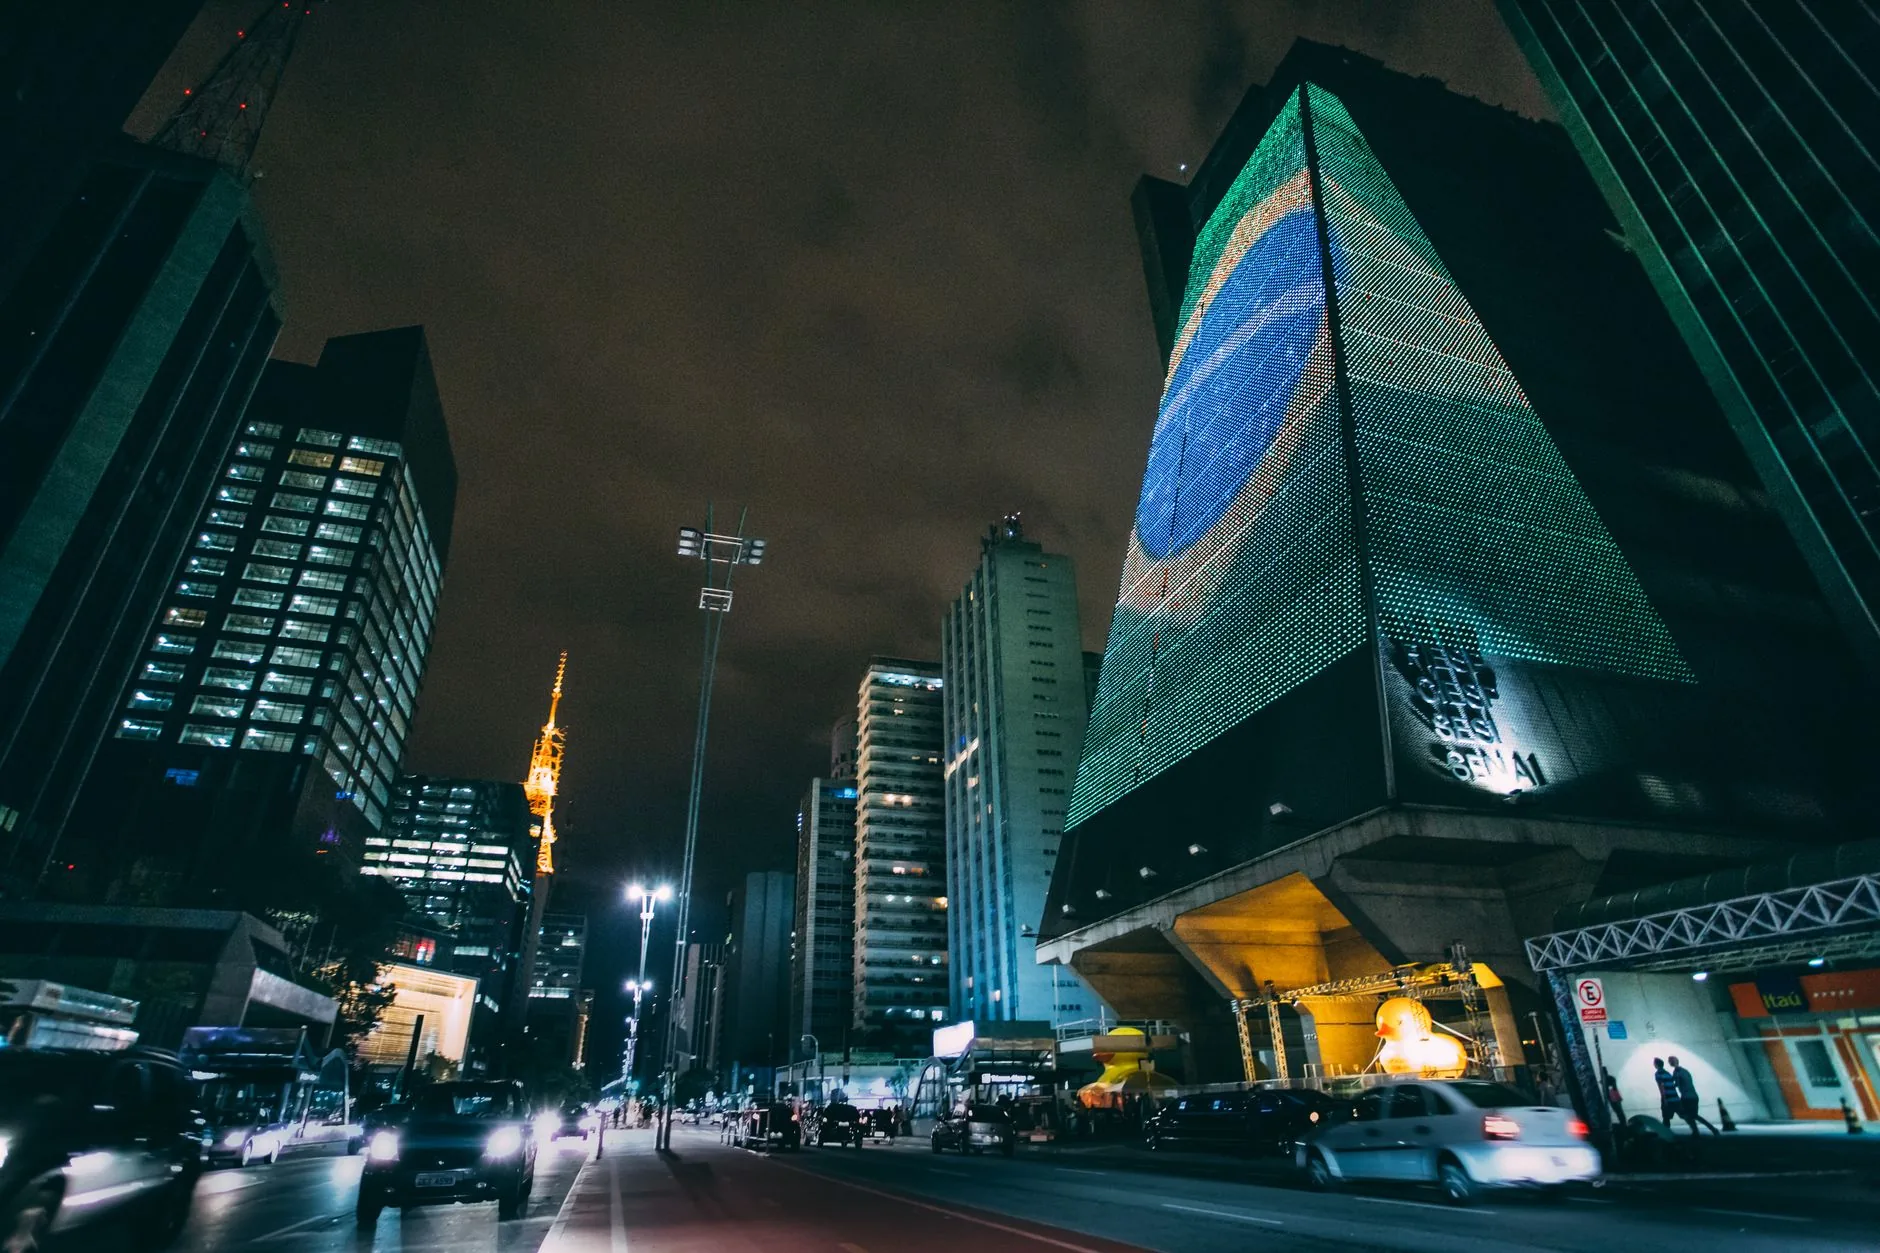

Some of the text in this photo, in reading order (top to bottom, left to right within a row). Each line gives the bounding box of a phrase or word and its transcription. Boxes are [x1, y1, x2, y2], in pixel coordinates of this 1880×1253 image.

[1433, 715, 1502, 743] SESI
[1447, 750, 1548, 786] SENAI
[1586, 986, 1596, 1000] E
[1763, 991, 1802, 1009] Itaú
